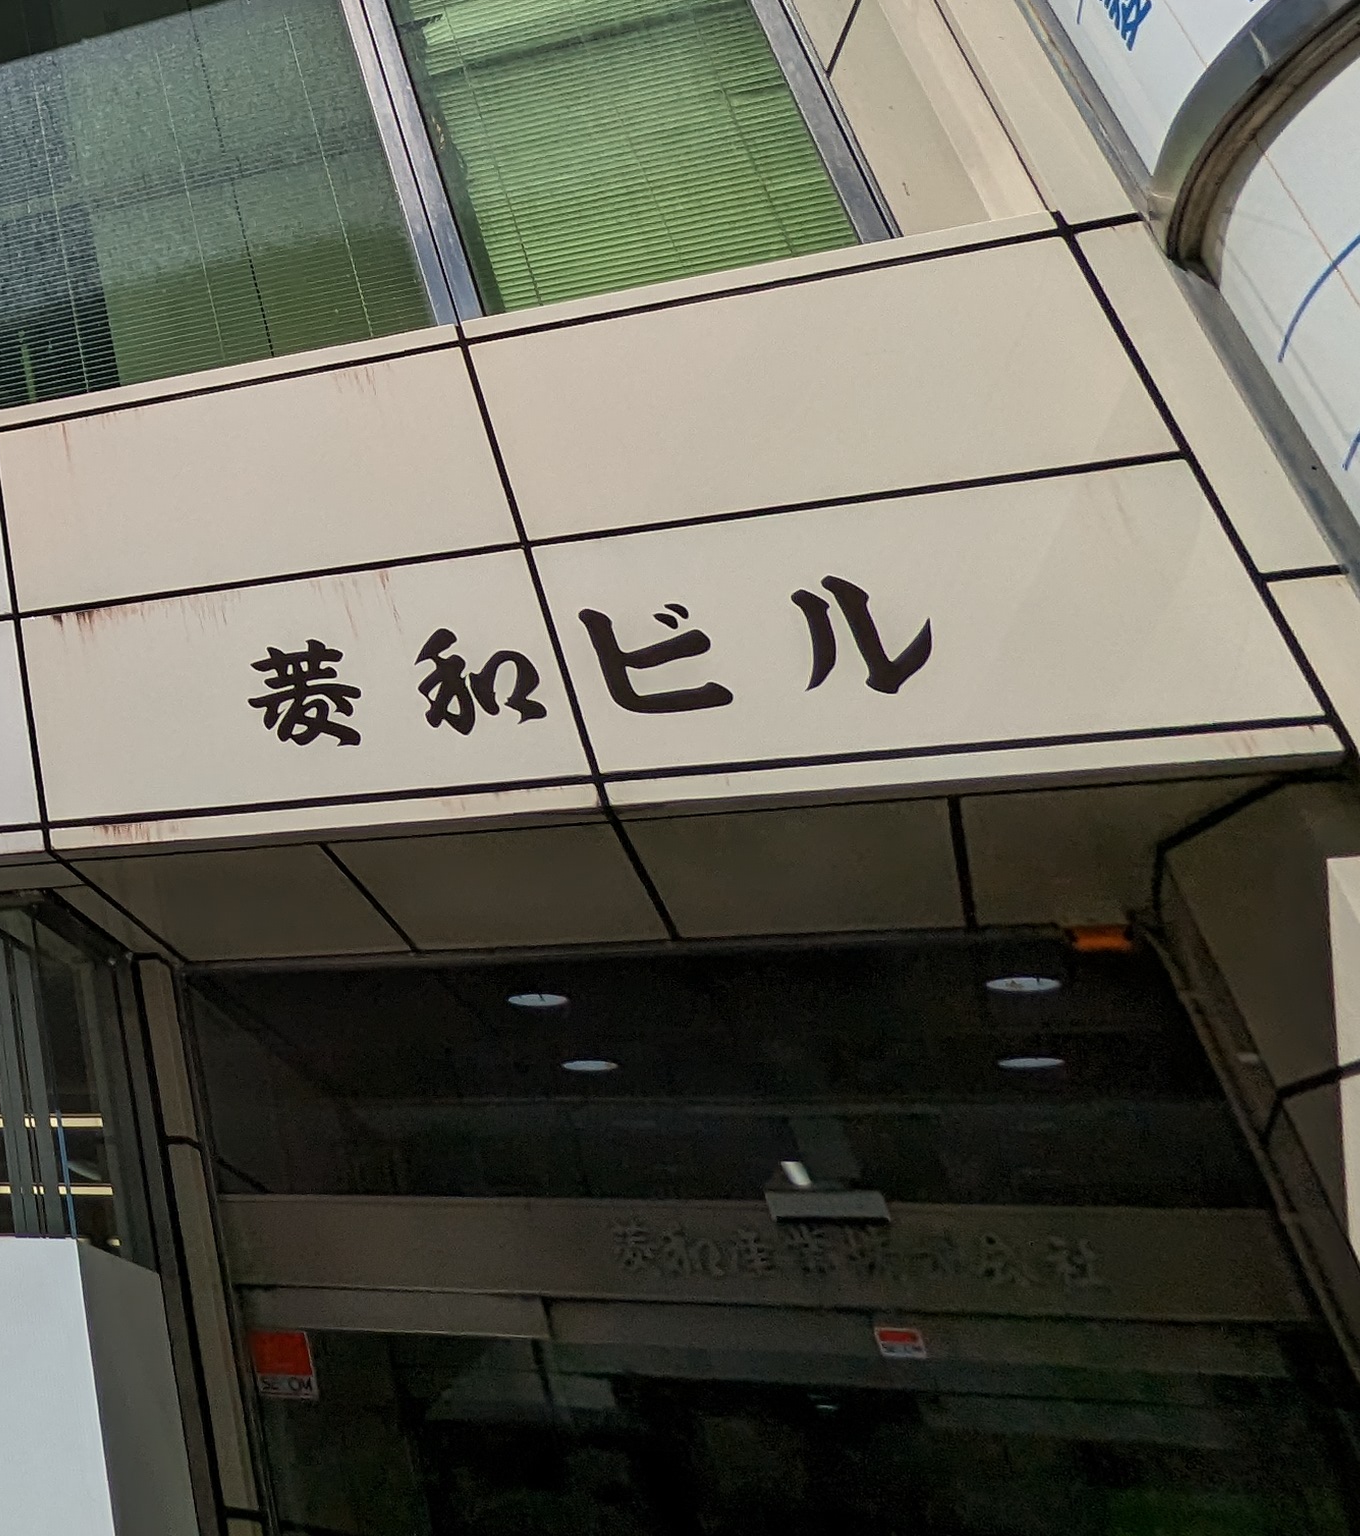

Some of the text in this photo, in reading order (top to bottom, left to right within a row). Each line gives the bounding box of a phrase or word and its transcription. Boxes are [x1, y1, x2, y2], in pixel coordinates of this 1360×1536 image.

[247, 576, 932, 747] 菱和ビル
[261, 1376, 313, 1392] SEOM
